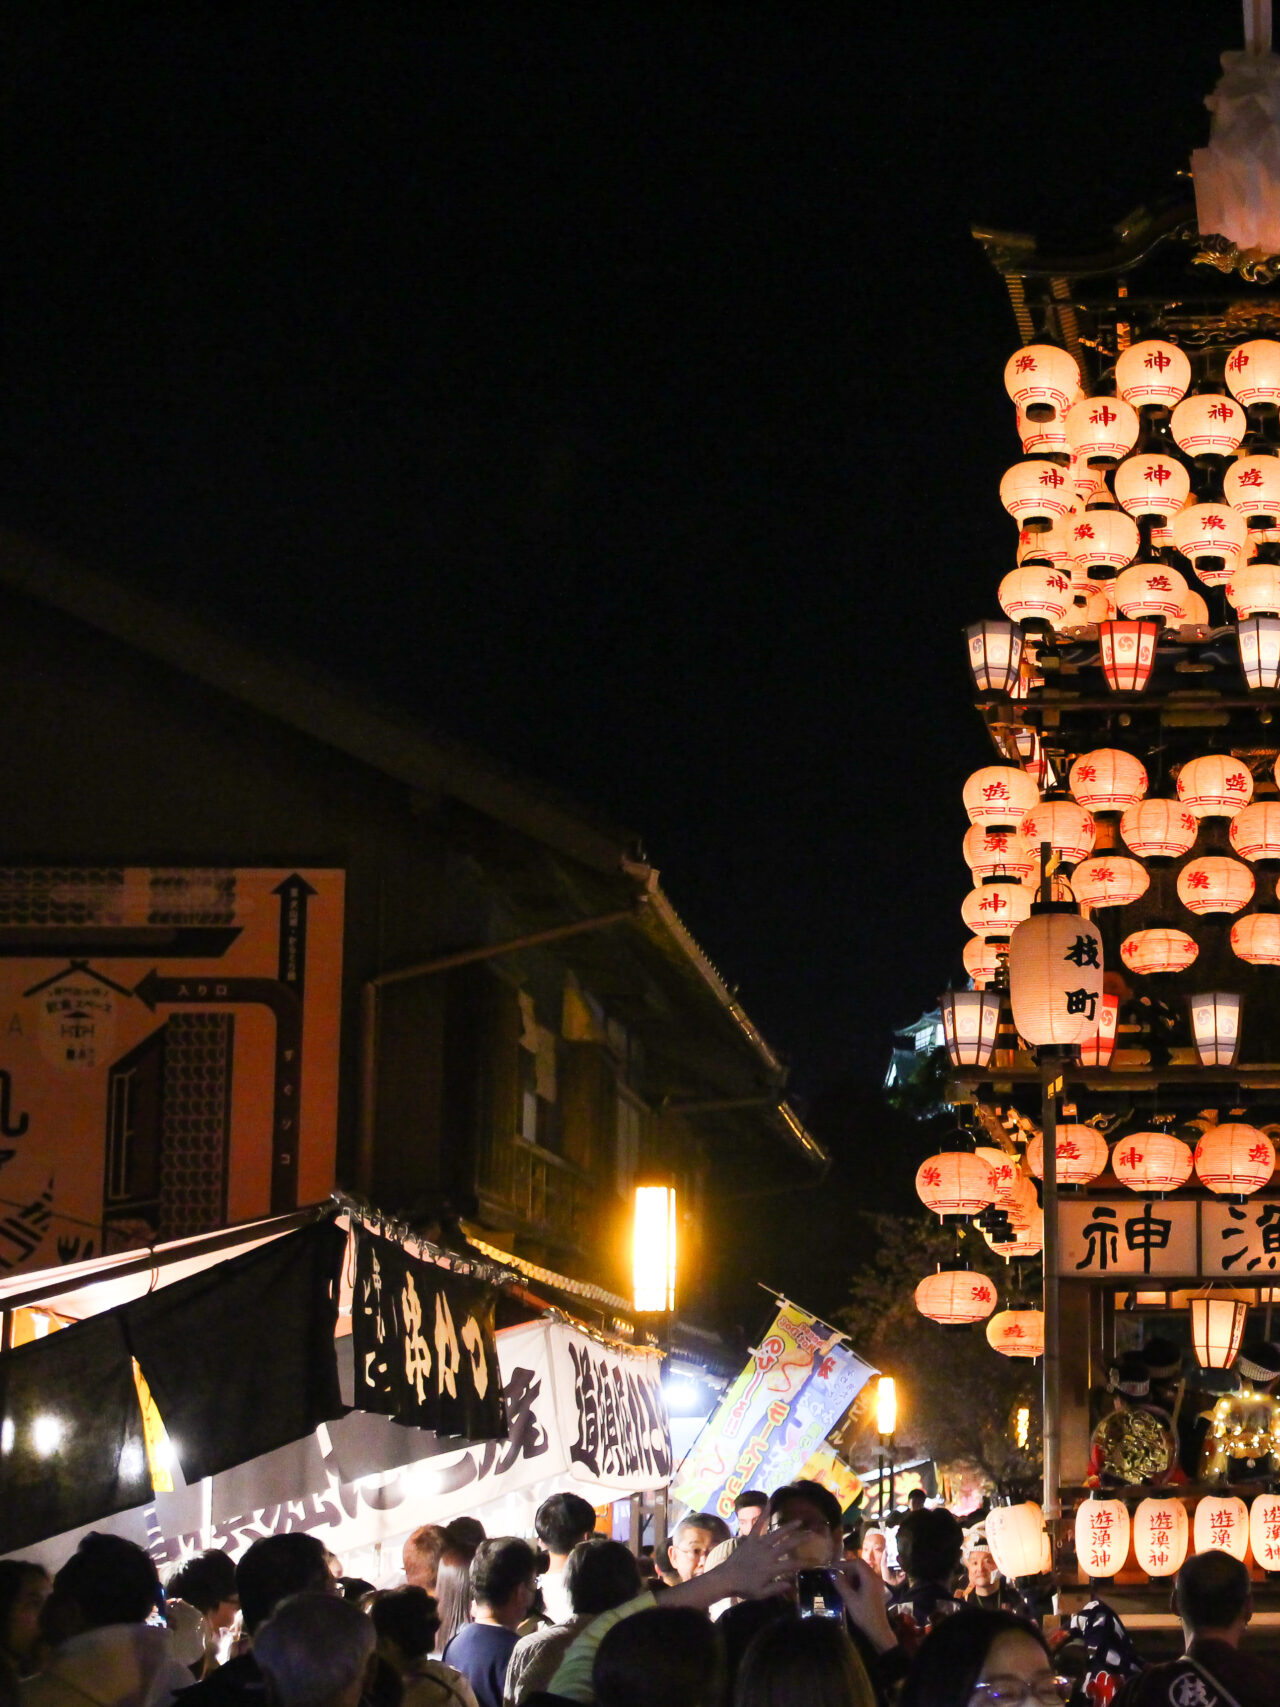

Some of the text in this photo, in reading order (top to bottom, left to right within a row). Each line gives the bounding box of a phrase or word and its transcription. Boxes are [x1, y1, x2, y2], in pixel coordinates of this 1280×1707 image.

[1144, 350, 1171, 373] 神
[1226, 348, 1249, 373] 神
[1089, 405, 1117, 427] 神
[1208, 403, 1233, 422] 神
[1039, 466, 1066, 489] 神
[1144, 464, 1172, 485] 神
[1238, 468, 1264, 487] 遊
[1046, 575, 1070, 592] 神
[1146, 576, 1172, 591] 遊
[1226, 773, 1250, 792] 遊
[979, 893, 1007, 912] 神
[1119, 1147, 1143, 1170] 神
[1076, 1203, 1172, 1274] 神
[1210, 1510, 1235, 1548] 遊漁
